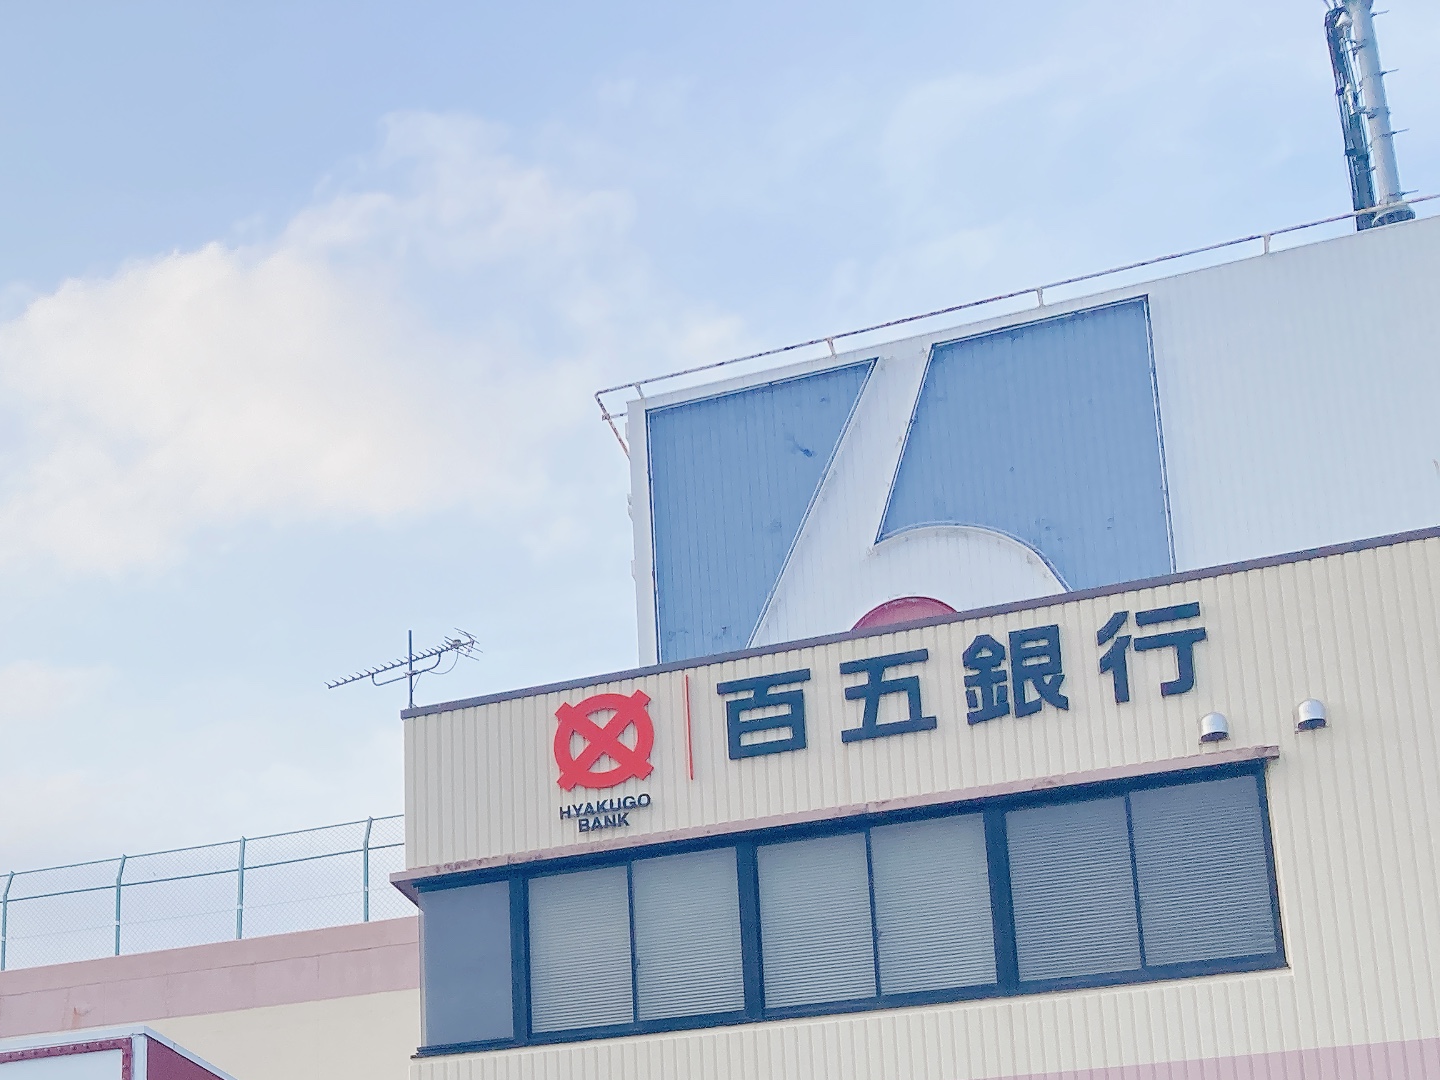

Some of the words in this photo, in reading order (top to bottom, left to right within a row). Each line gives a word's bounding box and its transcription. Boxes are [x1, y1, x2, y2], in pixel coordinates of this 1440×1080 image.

[717, 601, 1207, 761] 百五銀行
[560, 793, 651, 820] HYAKUGO
[578, 812, 630, 832] BANK
